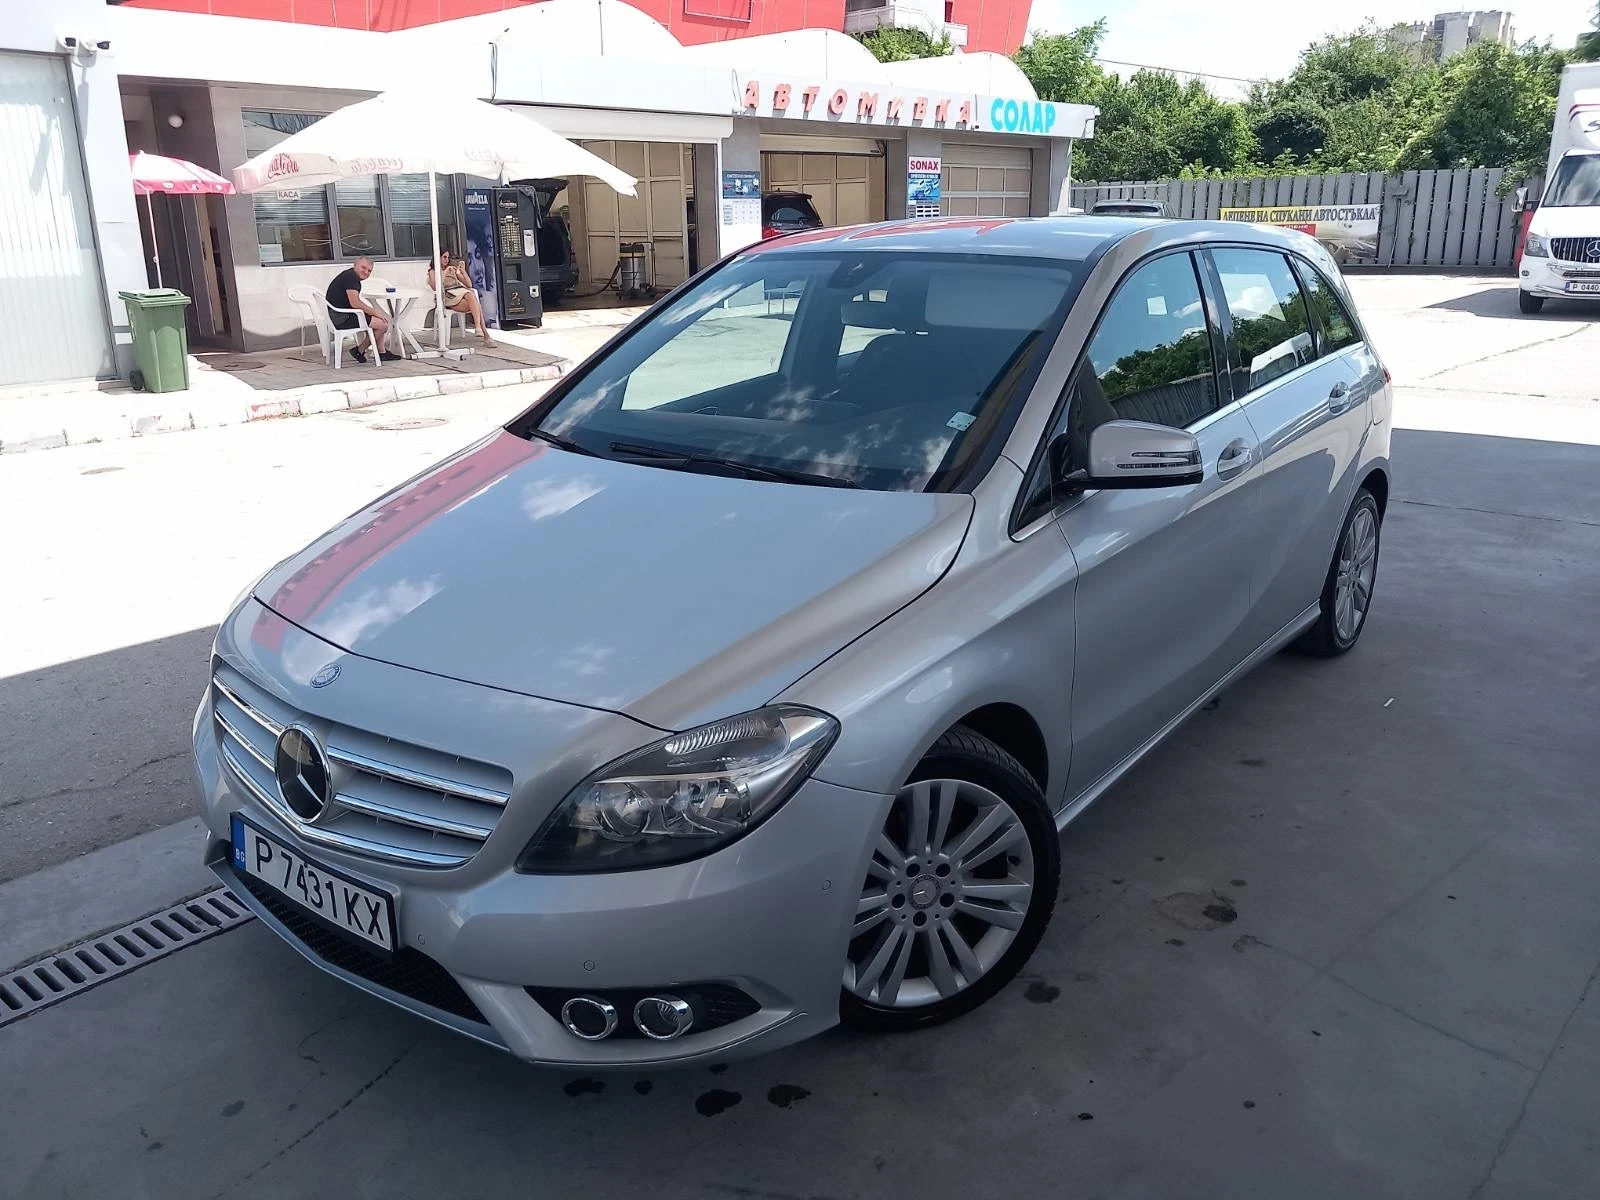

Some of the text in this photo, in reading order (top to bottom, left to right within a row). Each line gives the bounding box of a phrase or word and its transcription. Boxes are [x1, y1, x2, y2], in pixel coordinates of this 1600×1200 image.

[743, 80, 1056, 134] АВТОМИВКА СОЛАР
[910, 160, 939, 171] SONAX
[278, 191, 299, 199] КАСА
[465, 191, 489, 205] LAVAZZA
[1256, 210, 1268, 223] НА
[1269, 209, 1312, 222] СПУКАНИ
[235, 848, 245, 863] BG
